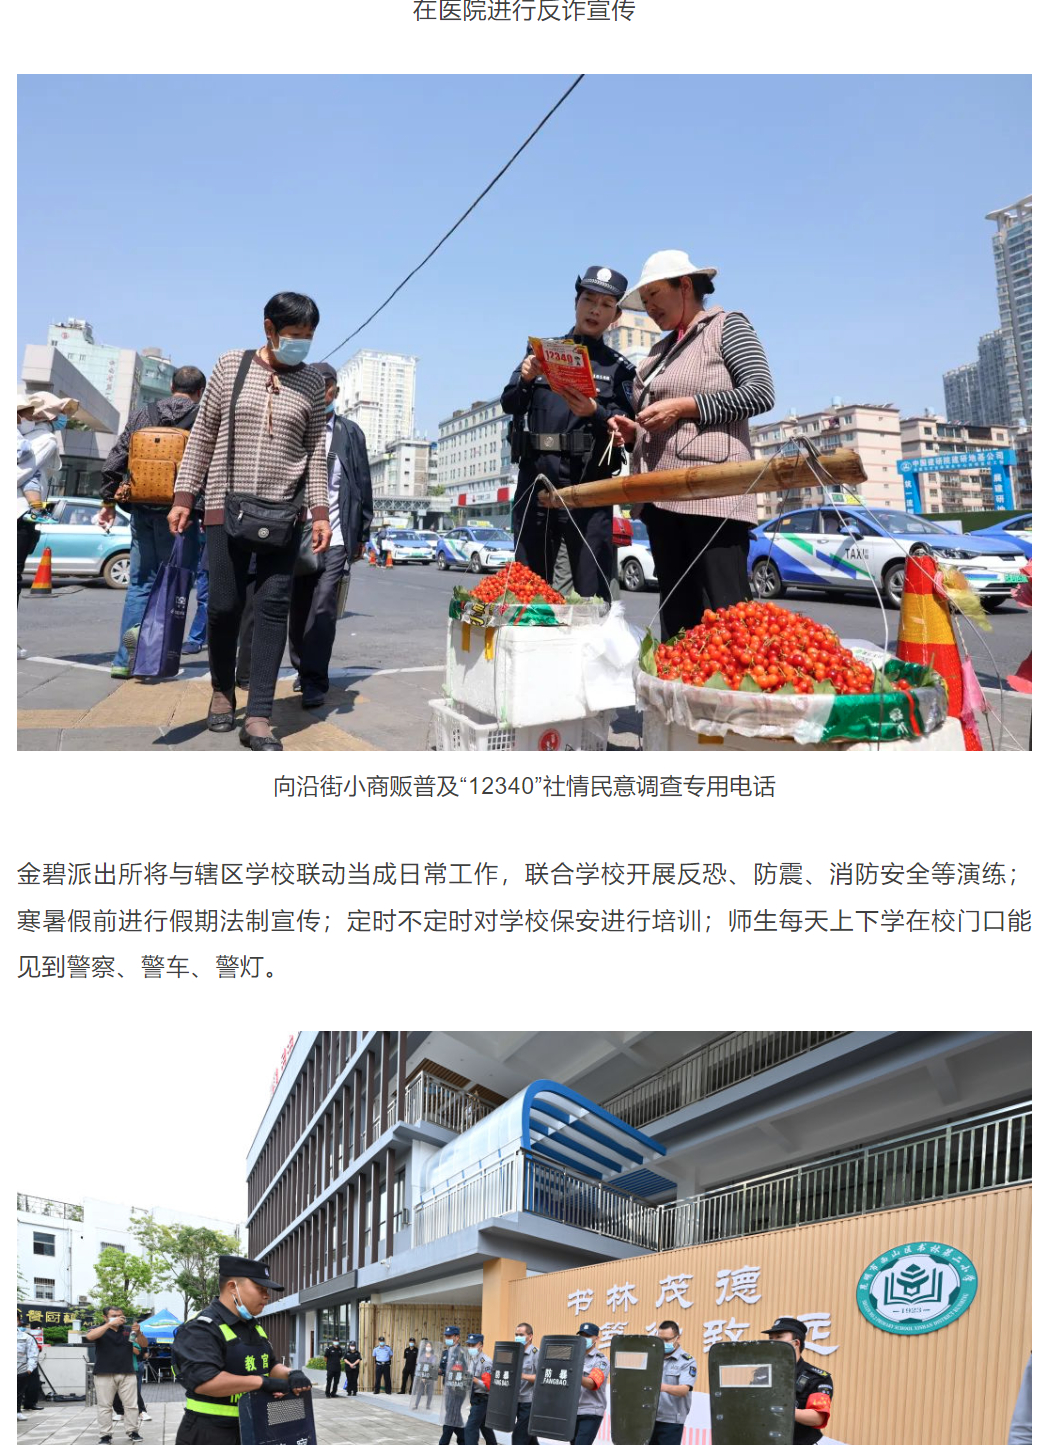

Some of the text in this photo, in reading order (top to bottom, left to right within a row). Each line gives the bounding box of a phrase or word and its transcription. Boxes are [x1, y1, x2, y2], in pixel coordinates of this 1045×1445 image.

[567, 1264, 763, 1317] 书林茂德
[244, 1352, 270, 1373] 教官
[494, 1369, 510, 1380] 防暴
[544, 1367, 568, 1380] 防暴
[542, 1377, 568, 1387] FANGBAO
